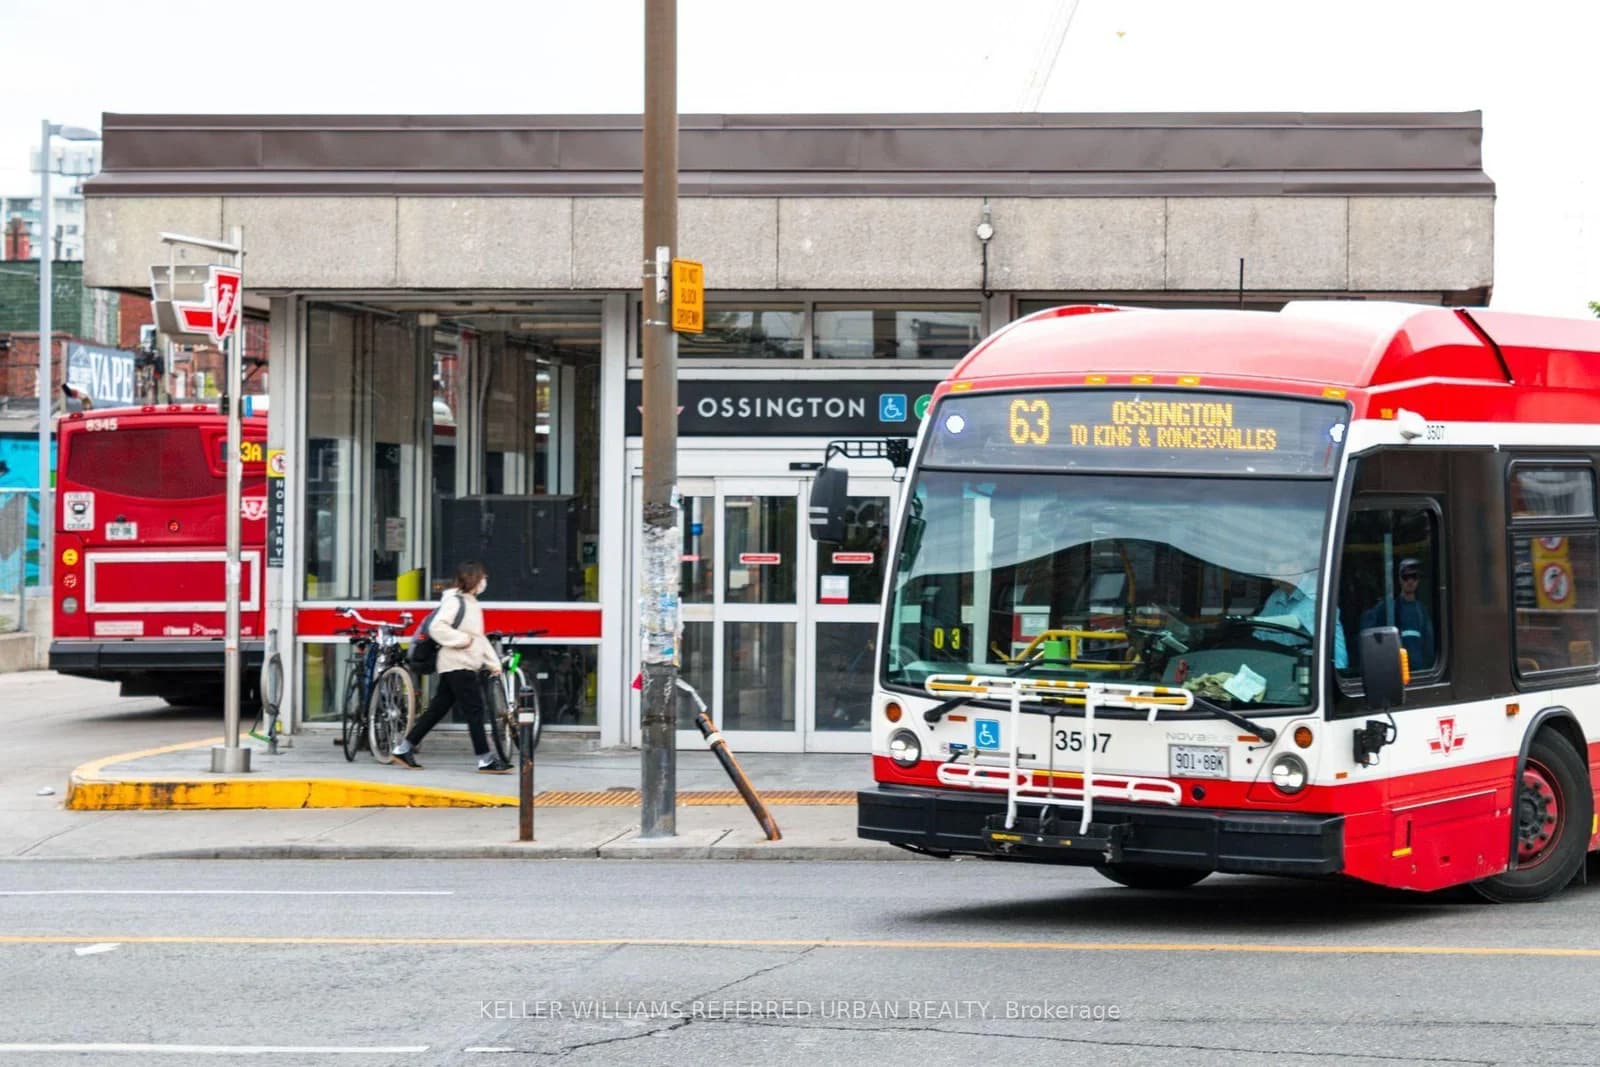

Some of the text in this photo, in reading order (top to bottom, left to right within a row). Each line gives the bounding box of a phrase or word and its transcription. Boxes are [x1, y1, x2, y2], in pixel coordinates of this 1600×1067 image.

[89, 352, 134, 403] VAPE
[697, 397, 866, 418] OSSINGTON
[1111, 401, 1234, 427] OSSINGTON
[1009, 399, 1050, 444] 63
[1070, 424, 1277, 450] TO KING & RONCESVALLES
[240, 441, 263, 462] 3A
[275, 480, 284, 500] NO
[275, 504, 284, 557] ENTRY
